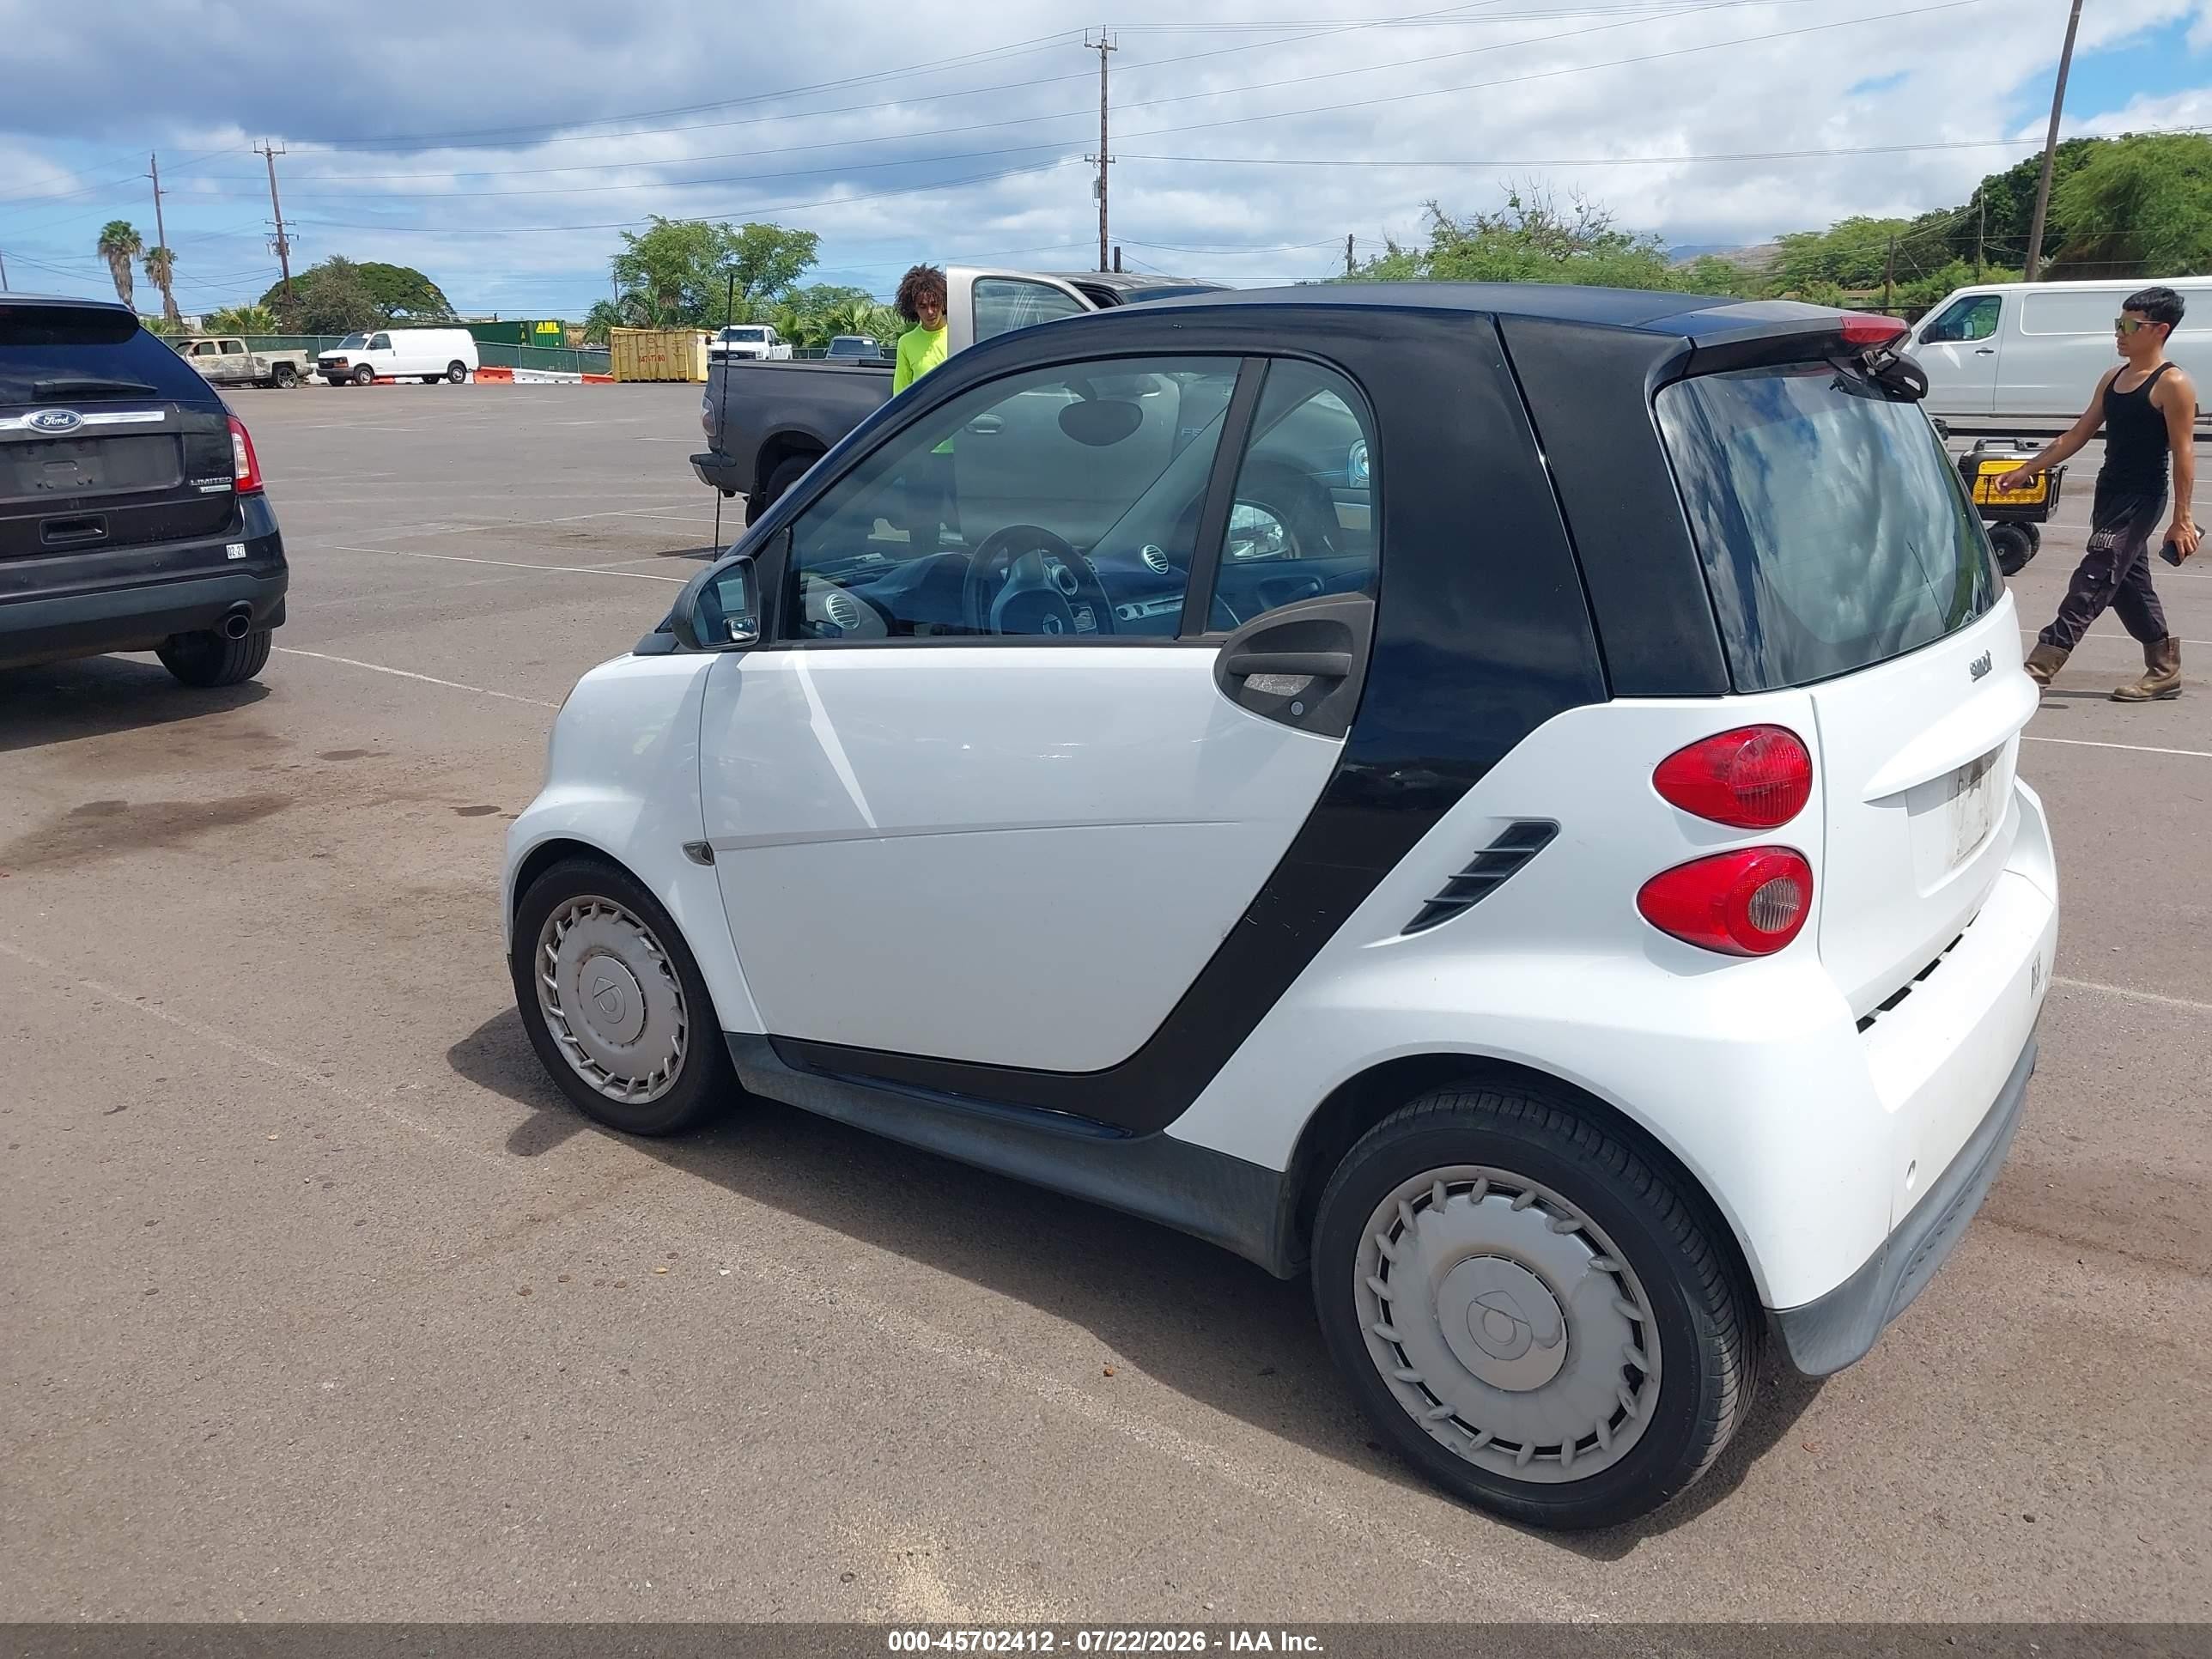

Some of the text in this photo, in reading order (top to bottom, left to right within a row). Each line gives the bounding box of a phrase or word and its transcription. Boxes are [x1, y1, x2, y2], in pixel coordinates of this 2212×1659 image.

[536, 321, 560, 333] AML
[43, 414, 70, 426] Ford
[190, 477, 233, 486] LIMITED
